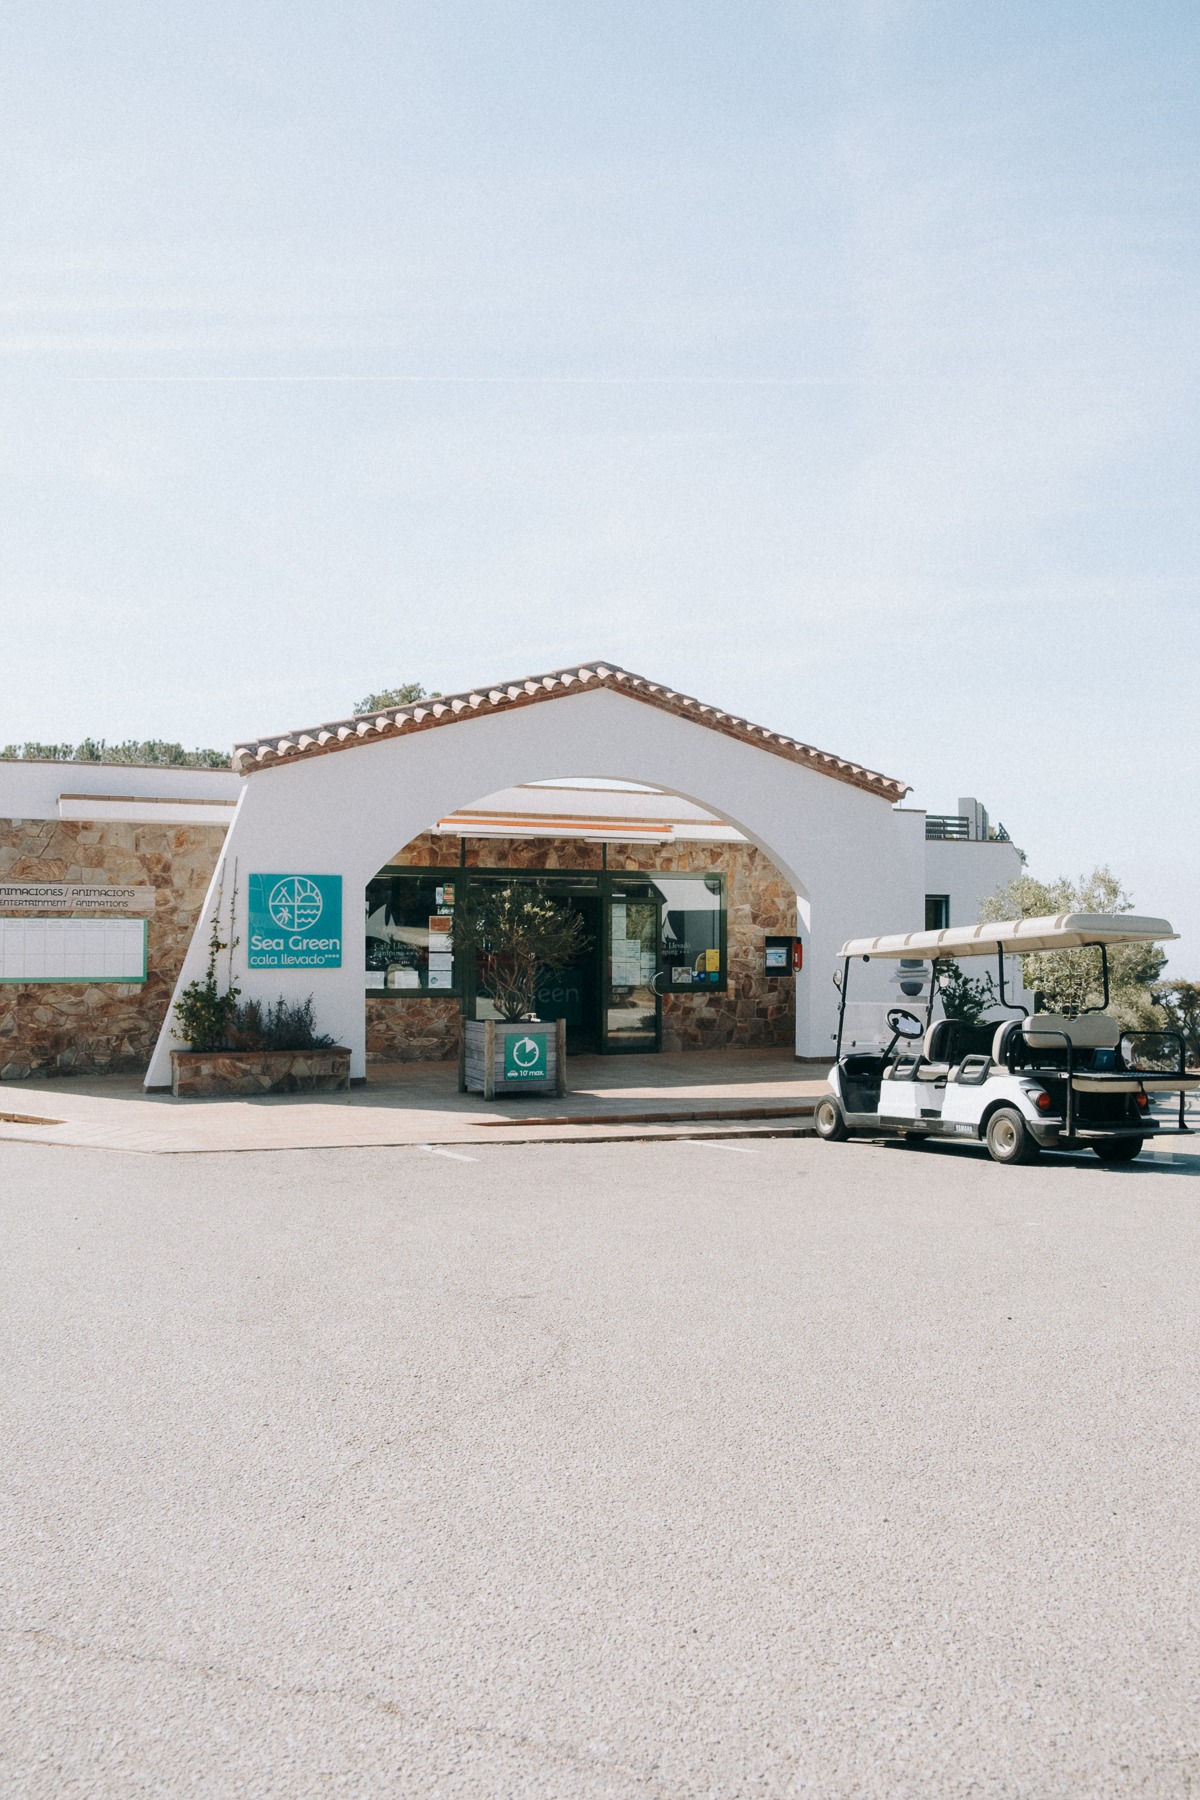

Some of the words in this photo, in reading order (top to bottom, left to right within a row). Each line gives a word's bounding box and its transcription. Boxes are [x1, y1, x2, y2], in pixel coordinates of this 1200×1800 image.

[0, 887, 64, 896] NIMACIONES
[72, 888, 136, 898] ANIMACIONS
[76, 900, 129, 908] ANIMATIONS
[250, 935, 285, 951] Sea
[288, 935, 340, 951] Green
[250, 954, 277, 965] cala
